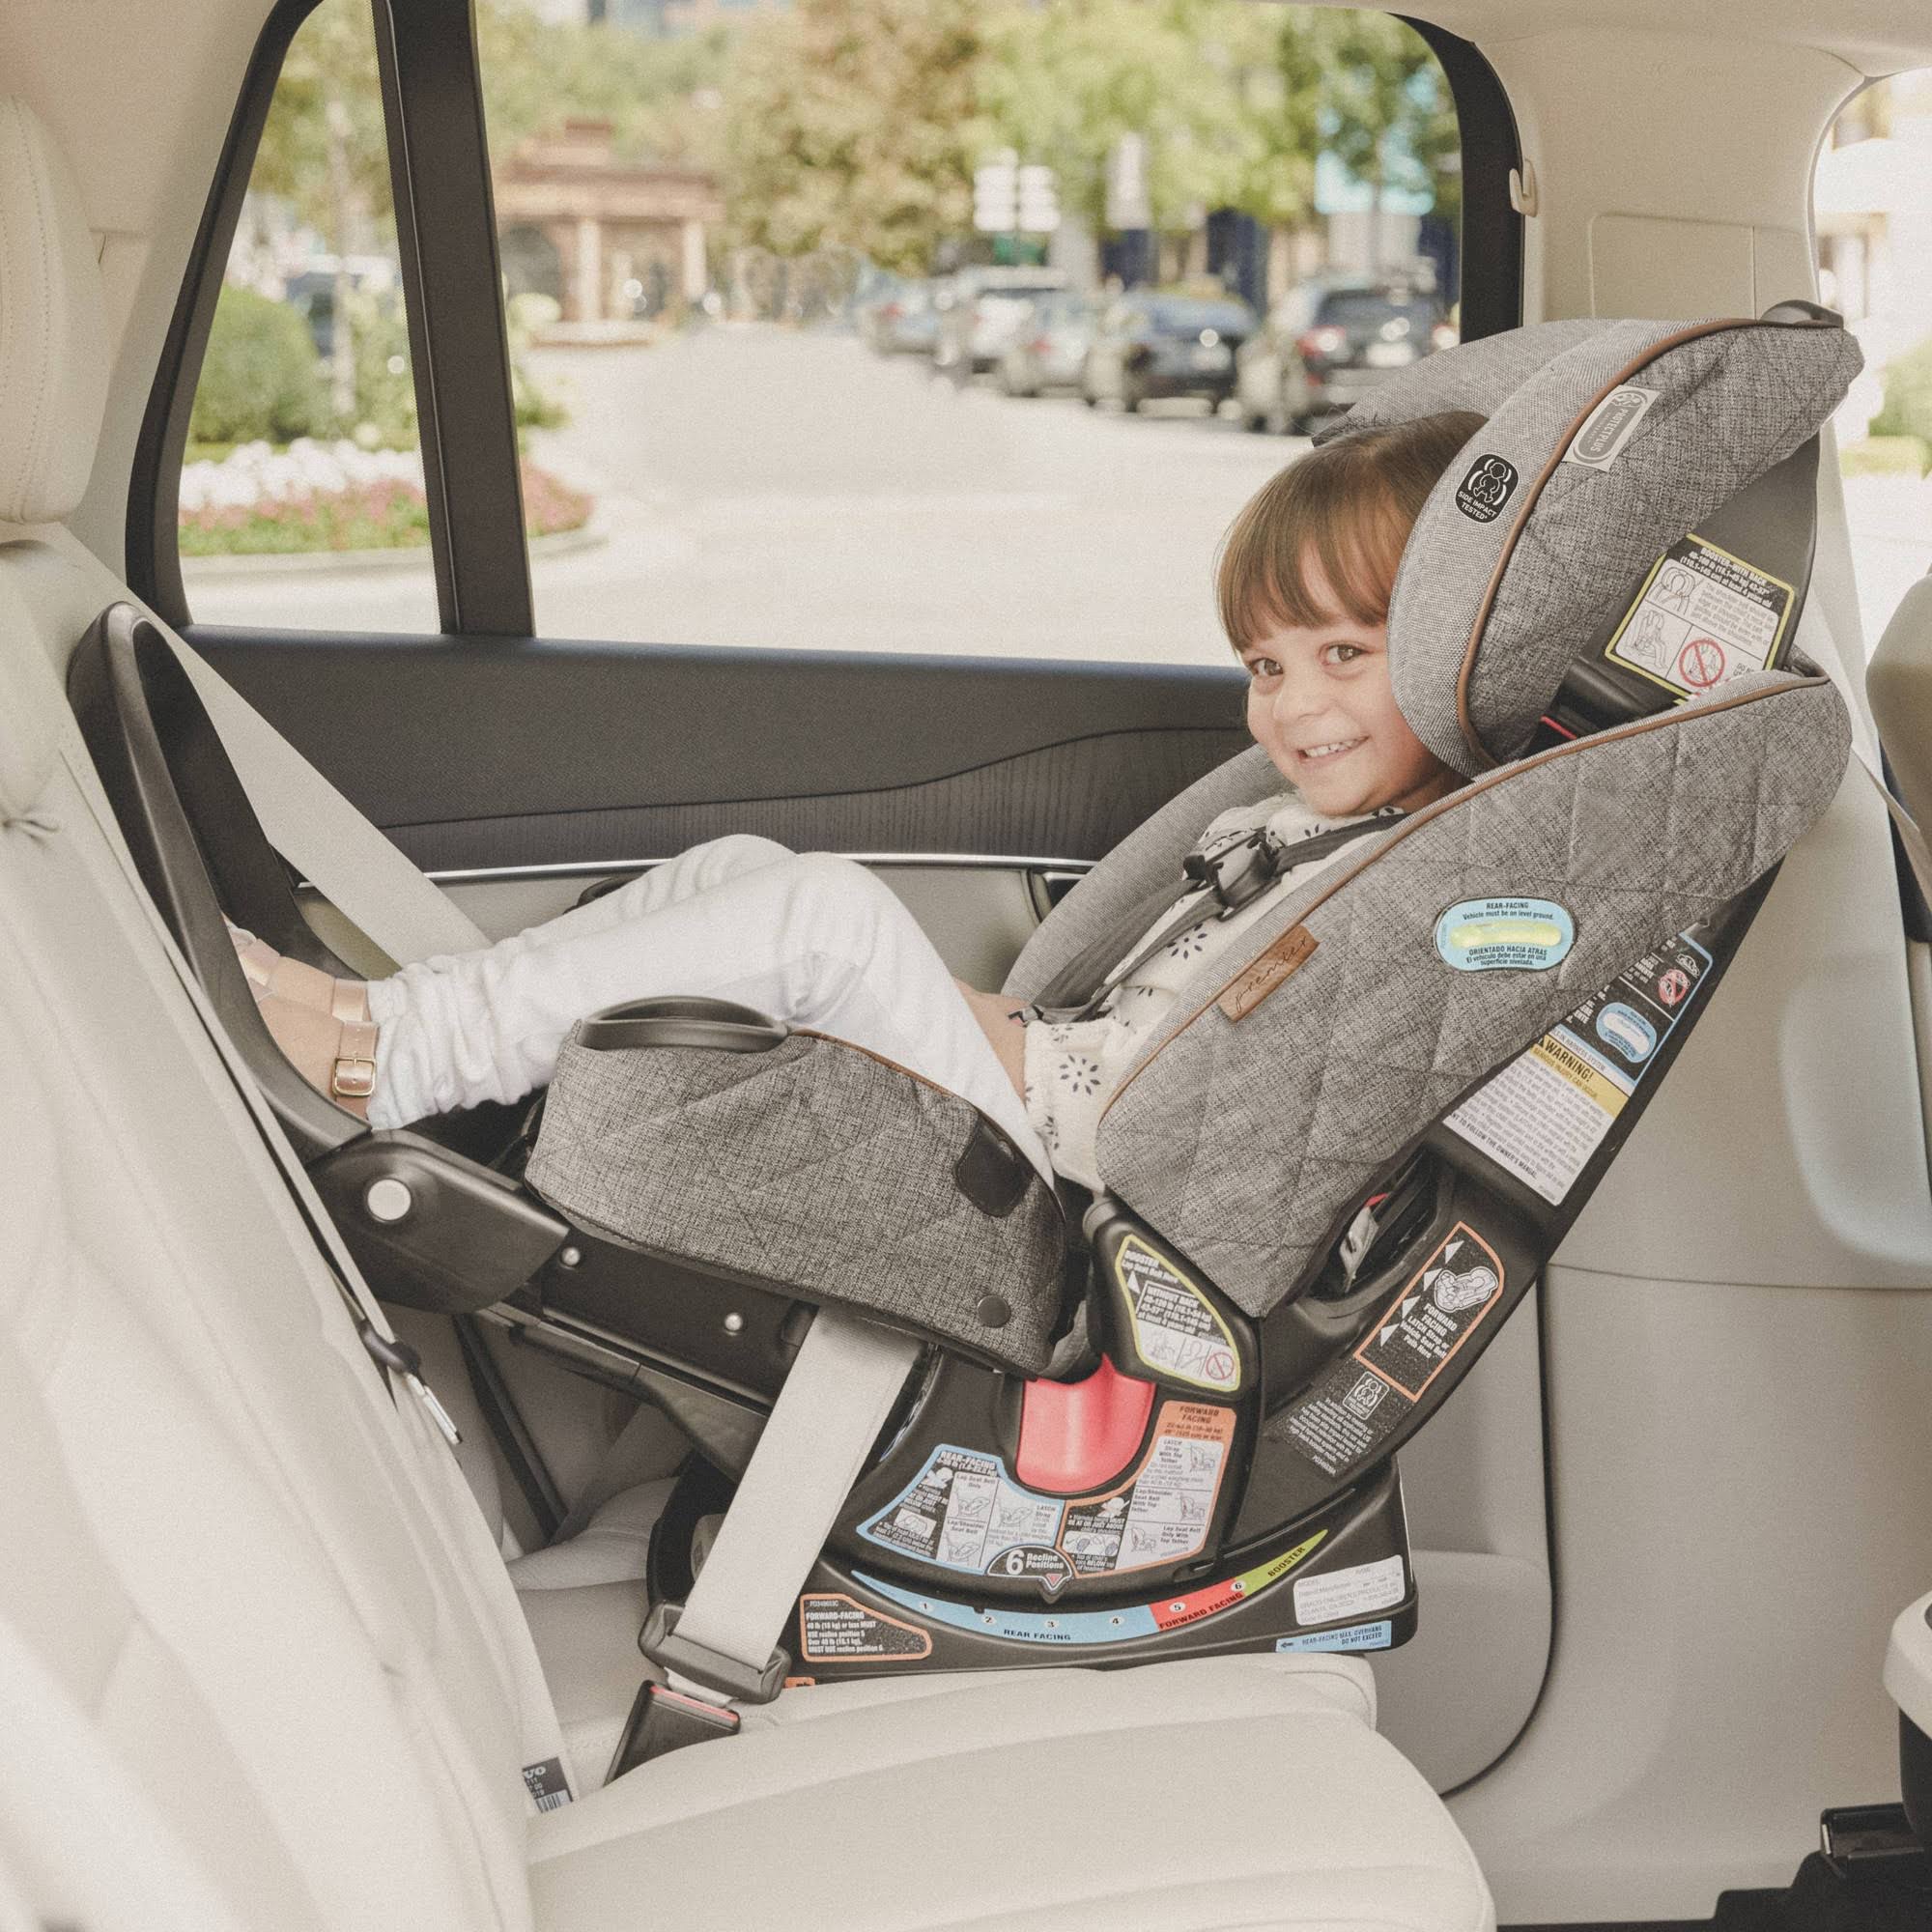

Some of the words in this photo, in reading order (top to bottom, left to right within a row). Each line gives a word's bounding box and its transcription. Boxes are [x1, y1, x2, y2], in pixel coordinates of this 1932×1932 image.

[1458, 491, 1472, 502] SIDE
[1472, 499, 1496, 517] IMPACT
[1728, 581, 1743, 592] least
[1747, 591, 1762, 604] years
[1762, 599, 1772, 608] old
[1463, 912, 1484, 921] Vehicle
[1533, 912, 1554, 921] ground.
[1468, 946, 1506, 956] ORIENTADO
[1236, 935, 1307, 1013] premier
[1542, 1040, 1594, 1082] WARNING!
[1465, 1122, 1486, 1140] FOLLOW
[1486, 1137, 1496, 1147] THE
[1495, 1145, 1519, 1163] OWNER'S
[1146, 1285, 1179, 1302] WITHOUT
[1179, 1295, 1199, 1308] BACK
[1420, 1314, 1447, 1336] FACING
[1423, 1302, 1458, 1331] FORWARD
[1399, 1320, 1422, 1340] Vehicle
[1420, 1336, 1435, 1350] Seat
[1433, 1346, 1447, 1358] Belt
[1406, 1315, 1428, 1333] LATCH
[1425, 1329, 1442, 1345] Strap
[1403, 1334, 1418, 1348] Path
[1416, 1344, 1432, 1358] Here
[1179, 1405, 1219, 1417] FORWARD
[1181, 1413, 1211, 1423] FACING
[941, 1450, 995, 1469] REAR-FACING
[1006, 1548, 1025, 1576] 6
[1026, 1552, 1060, 1562] Recline
[1267, 1546, 1306, 1577] BOOSTER
[806, 1611, 866, 1621] FORWARD-FACING
[1159, 1608, 1208, 1630] FORWARD
[1208, 1592, 1244, 1611] FACING
[1004, 1629, 1033, 1639] REAR
[1353, 1626, 1382, 1636] OVERHANG
[1361, 1632, 1382, 1641] EXCEED
